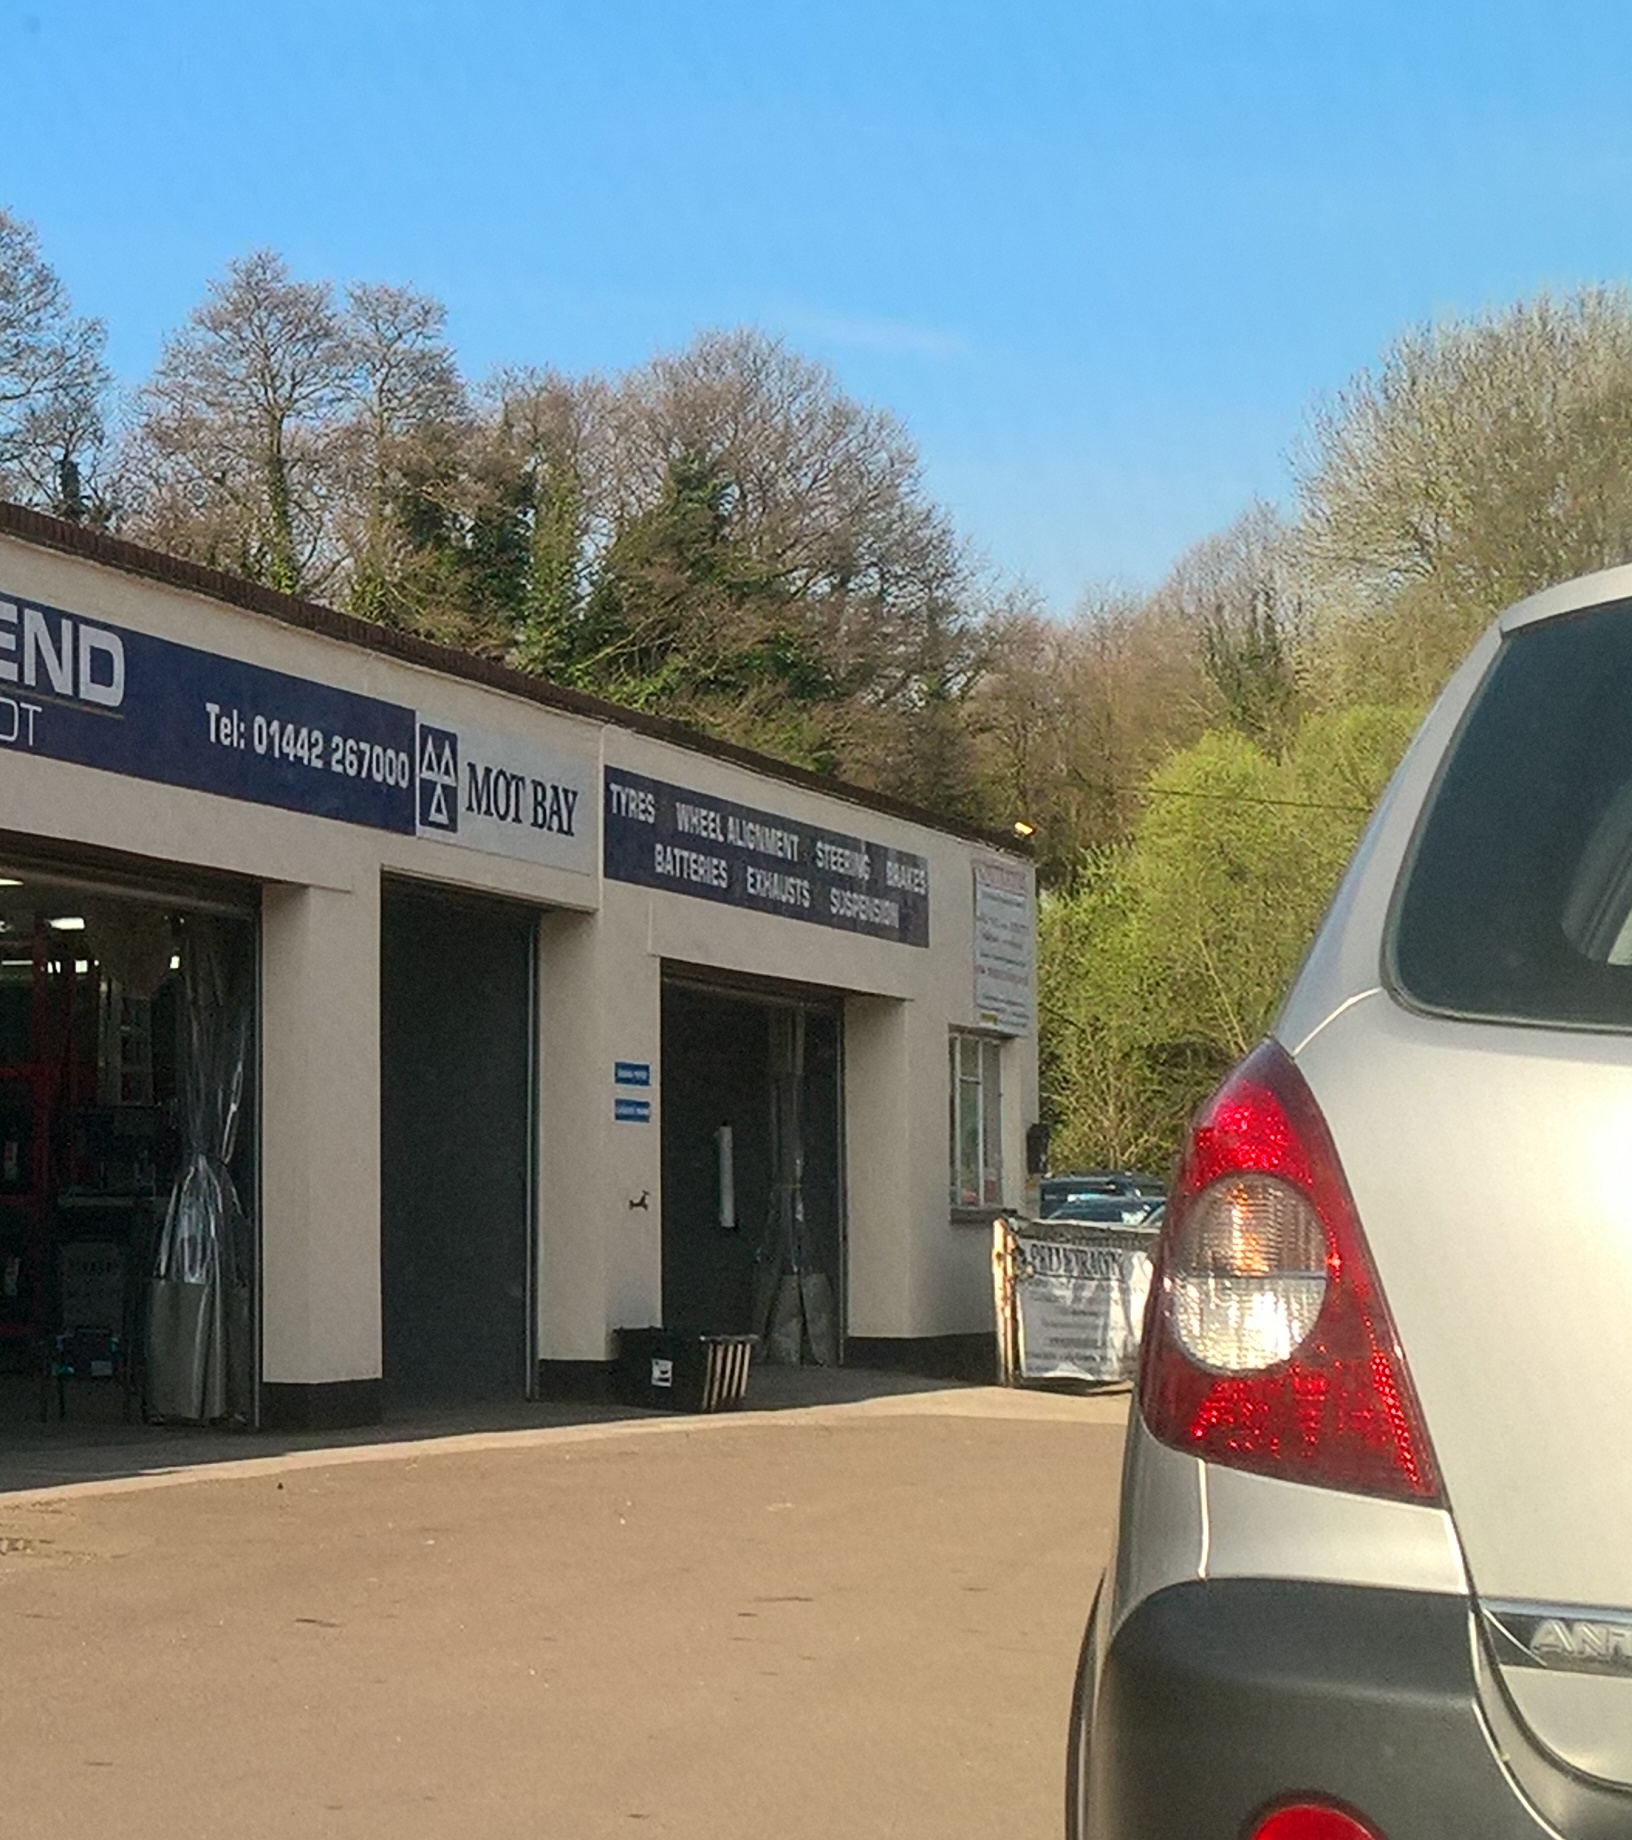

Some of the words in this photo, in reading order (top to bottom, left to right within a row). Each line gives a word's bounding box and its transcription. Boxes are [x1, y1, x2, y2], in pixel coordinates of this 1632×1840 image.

[204, 702, 246, 750] Tel:
[252, 714, 324, 769] 01442
[330, 735, 410, 790] 267000
[465, 761, 526, 825] MOT
[530, 781, 579, 837] BAY
[609, 782, 656, 825] TYRES
[675, 801, 725, 843] WHEEL
[726, 815, 800, 863] ALIGNMENT
[815, 840, 871, 881] STEERING
[885, 860, 929, 896] BRAKES
[653, 842, 729, 889] BATTERIES
[746, 865, 811, 909] EXHAUSTS
[829, 886, 900, 929] SUSPENSION
